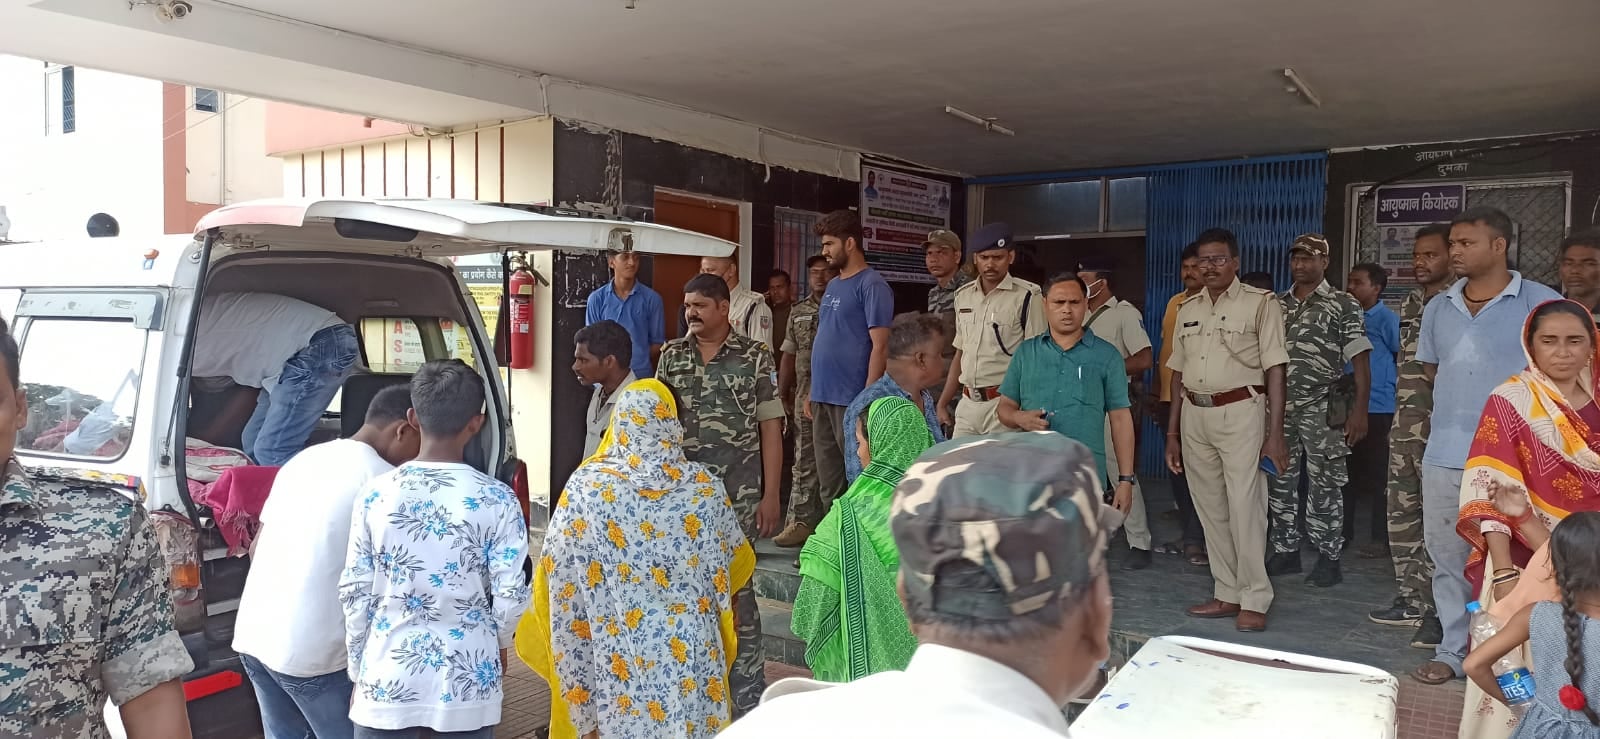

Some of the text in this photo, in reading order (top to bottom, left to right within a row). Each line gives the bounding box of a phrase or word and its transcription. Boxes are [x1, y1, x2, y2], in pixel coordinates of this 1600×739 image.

[1438, 163, 1469, 176] दुमका
[1380, 192, 1459, 218] आयुष्मान कियोस्क
